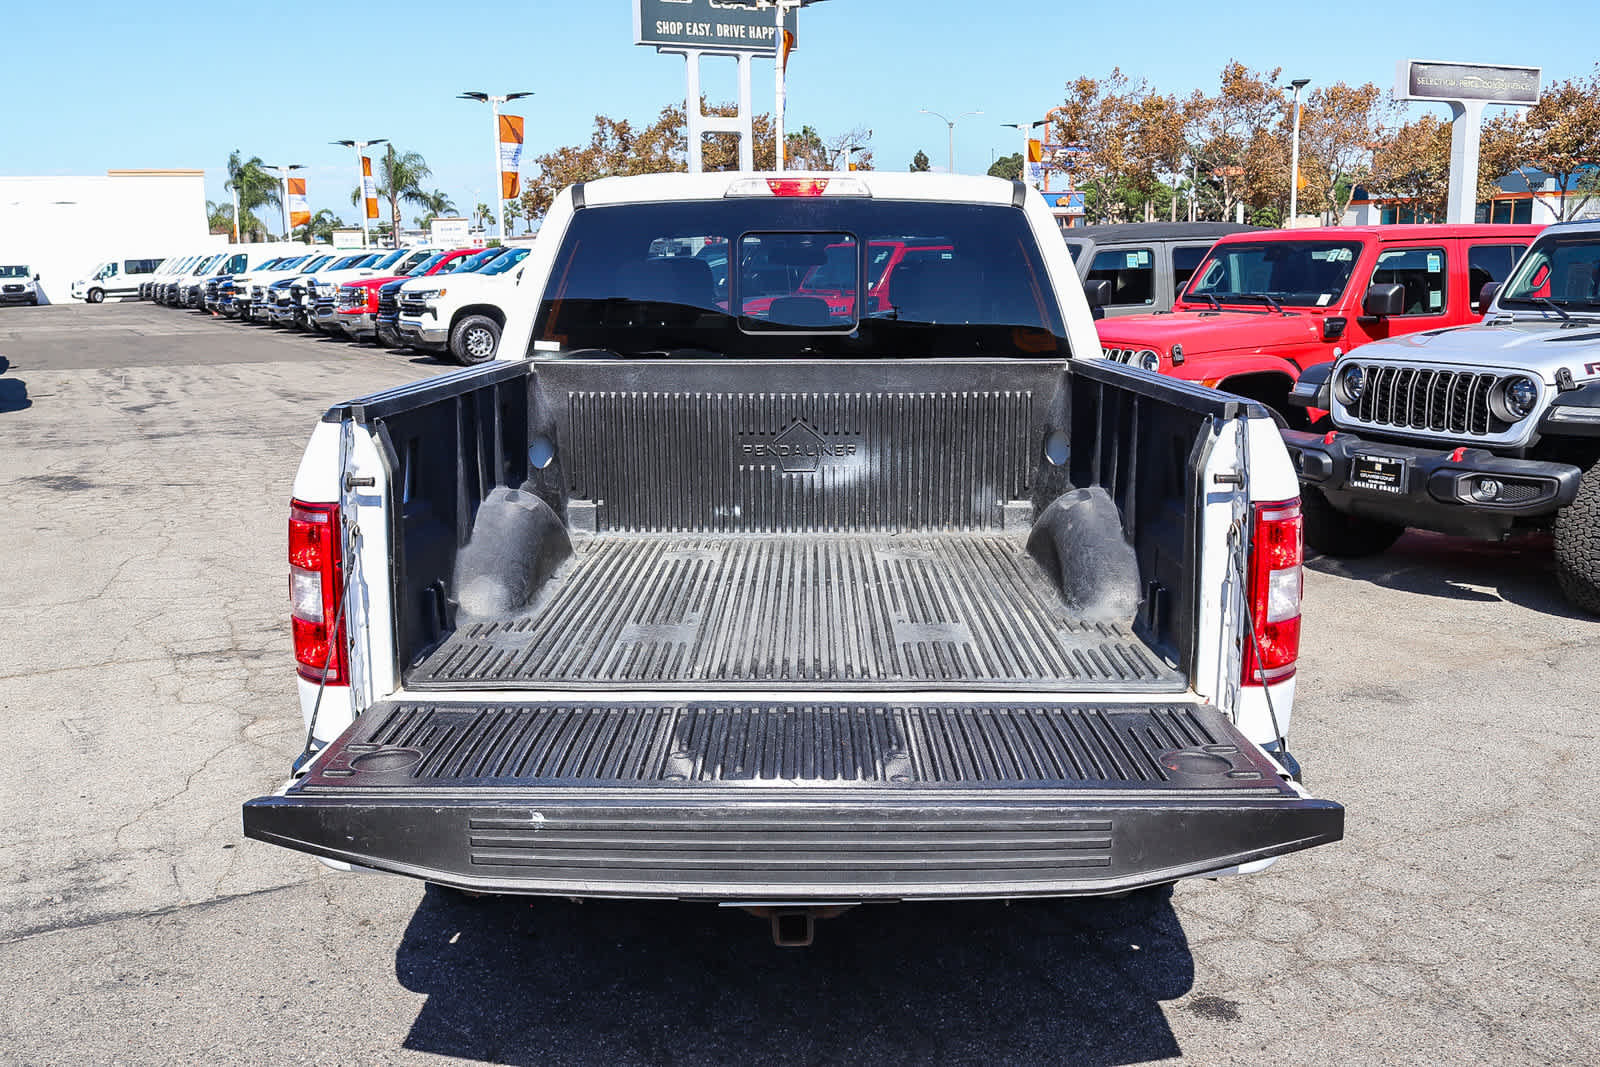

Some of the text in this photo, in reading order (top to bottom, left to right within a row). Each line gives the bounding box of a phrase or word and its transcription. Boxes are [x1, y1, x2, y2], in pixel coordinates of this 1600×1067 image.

[656, 20, 776, 40] SHOP EASY. DRIVE HAPP
[743, 444, 856, 457] PENDALINER
